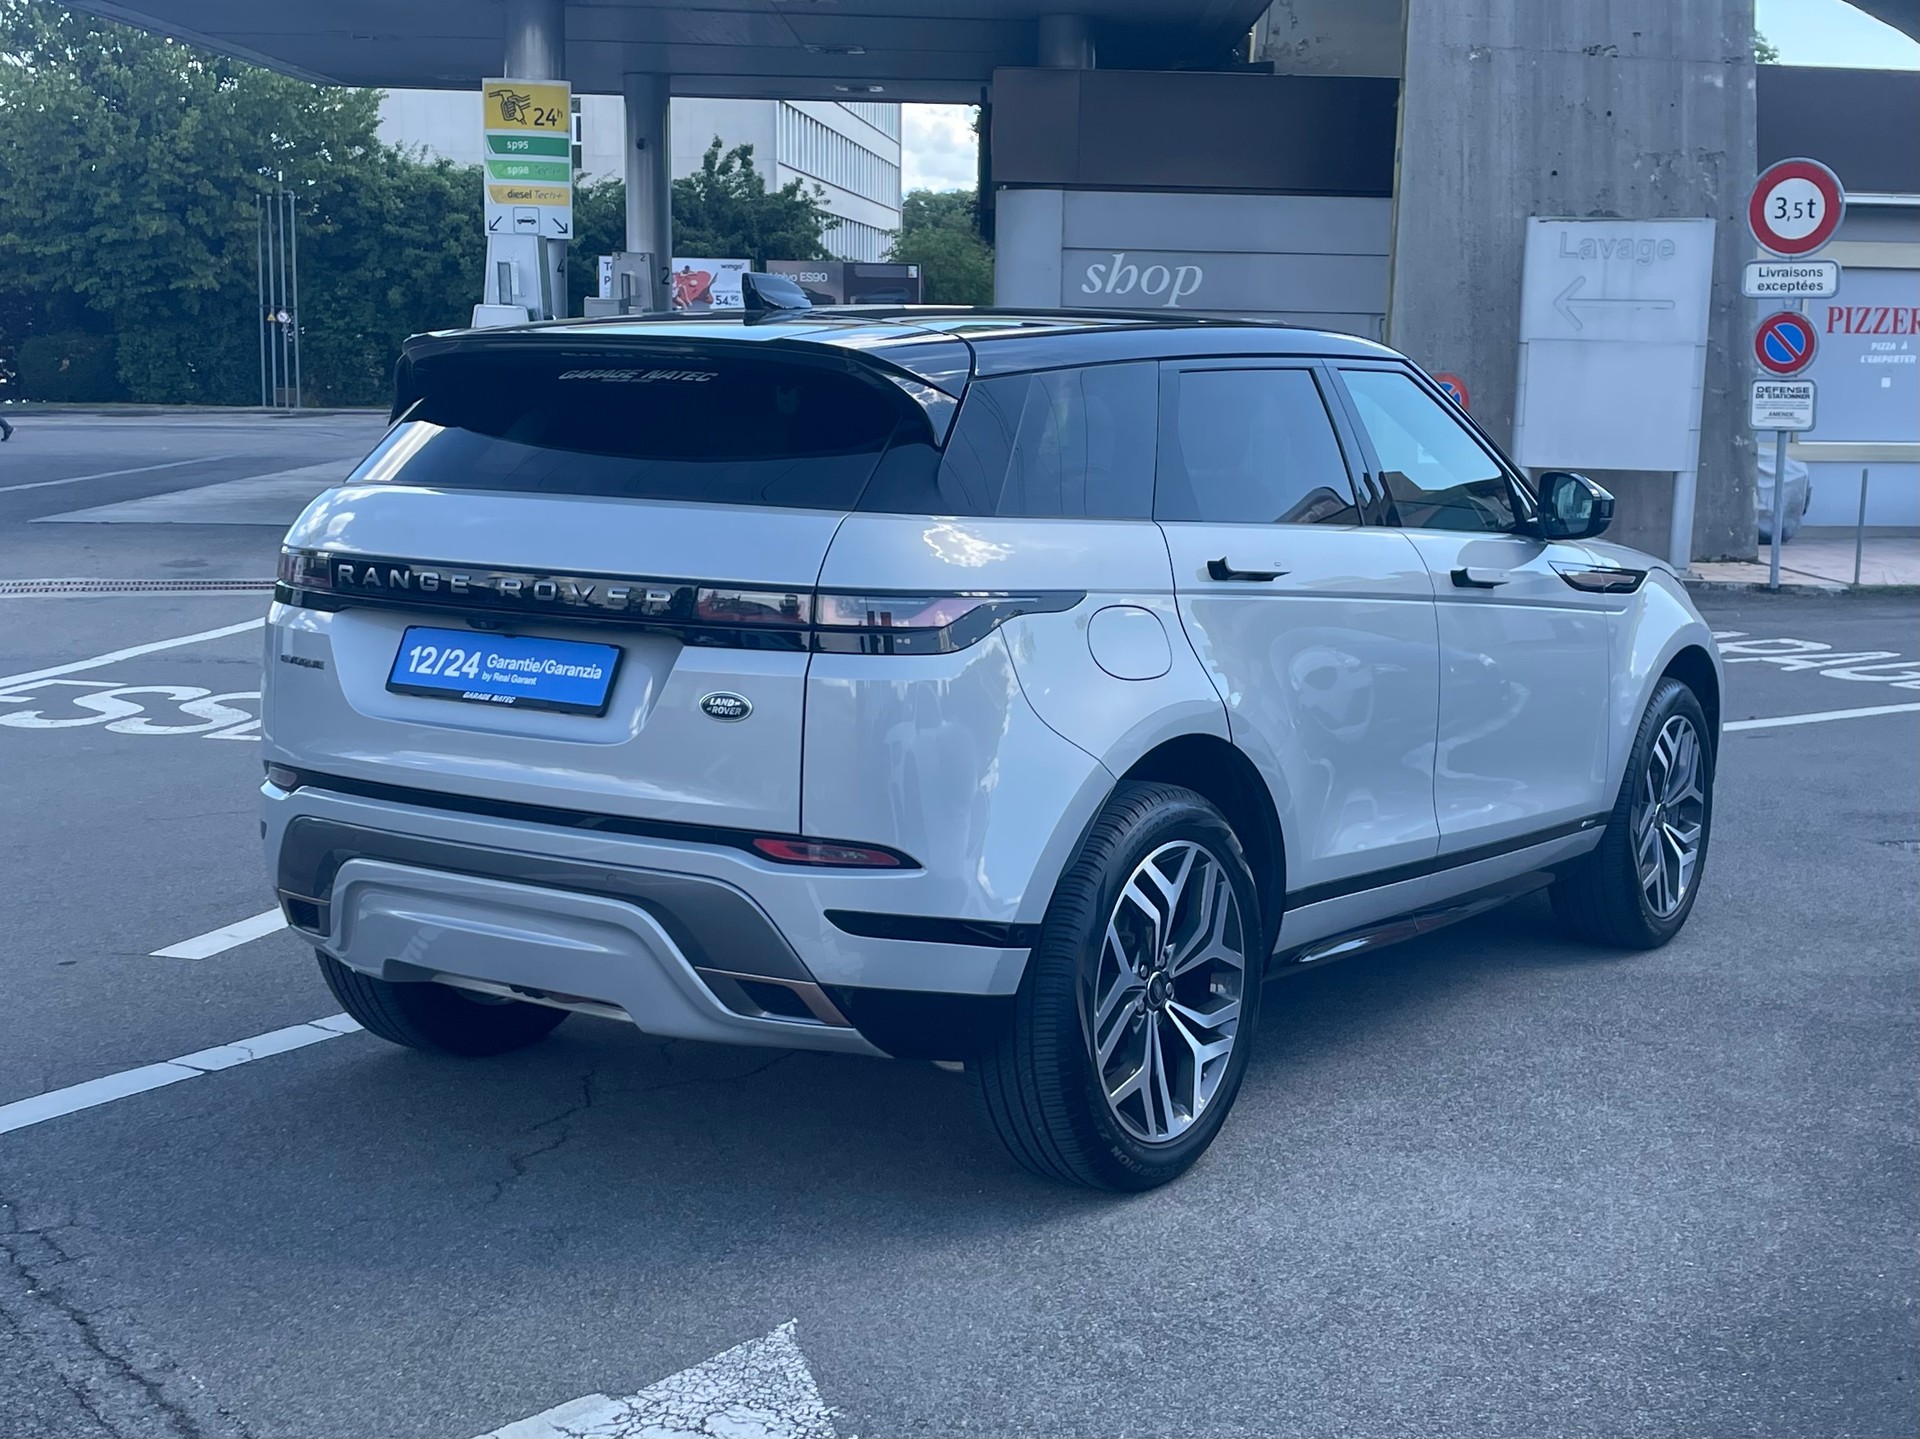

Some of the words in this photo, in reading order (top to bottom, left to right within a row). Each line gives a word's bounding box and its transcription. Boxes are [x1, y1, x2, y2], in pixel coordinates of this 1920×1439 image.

[507, 141, 529, 151] sp95
[507, 166, 530, 176] sp98
[507, 189, 532, 199] diesel
[1559, 231, 1676, 267] Lavage
[556, 259, 565, 278] 4
[1758, 266, 1823, 278] Livraisons
[661, 267, 670, 285] 2
[800, 272, 828, 283] ES90
[1081, 252, 1203, 308] shop
[1757, 280, 1823, 294] exceptées
[337, 564, 471, 594] RANGE
[500, 578, 673, 611] ROVER
[408, 645, 482, 679] 12/24
[487, 653, 602, 680] Garantie/Garanzia
[481, 671, 492, 682] by
[493, 673, 511, 683] Real
[511, 675, 537, 686] Garant
[710, 697, 734, 706] LAND
[711, 706, 741, 716] ROVER
